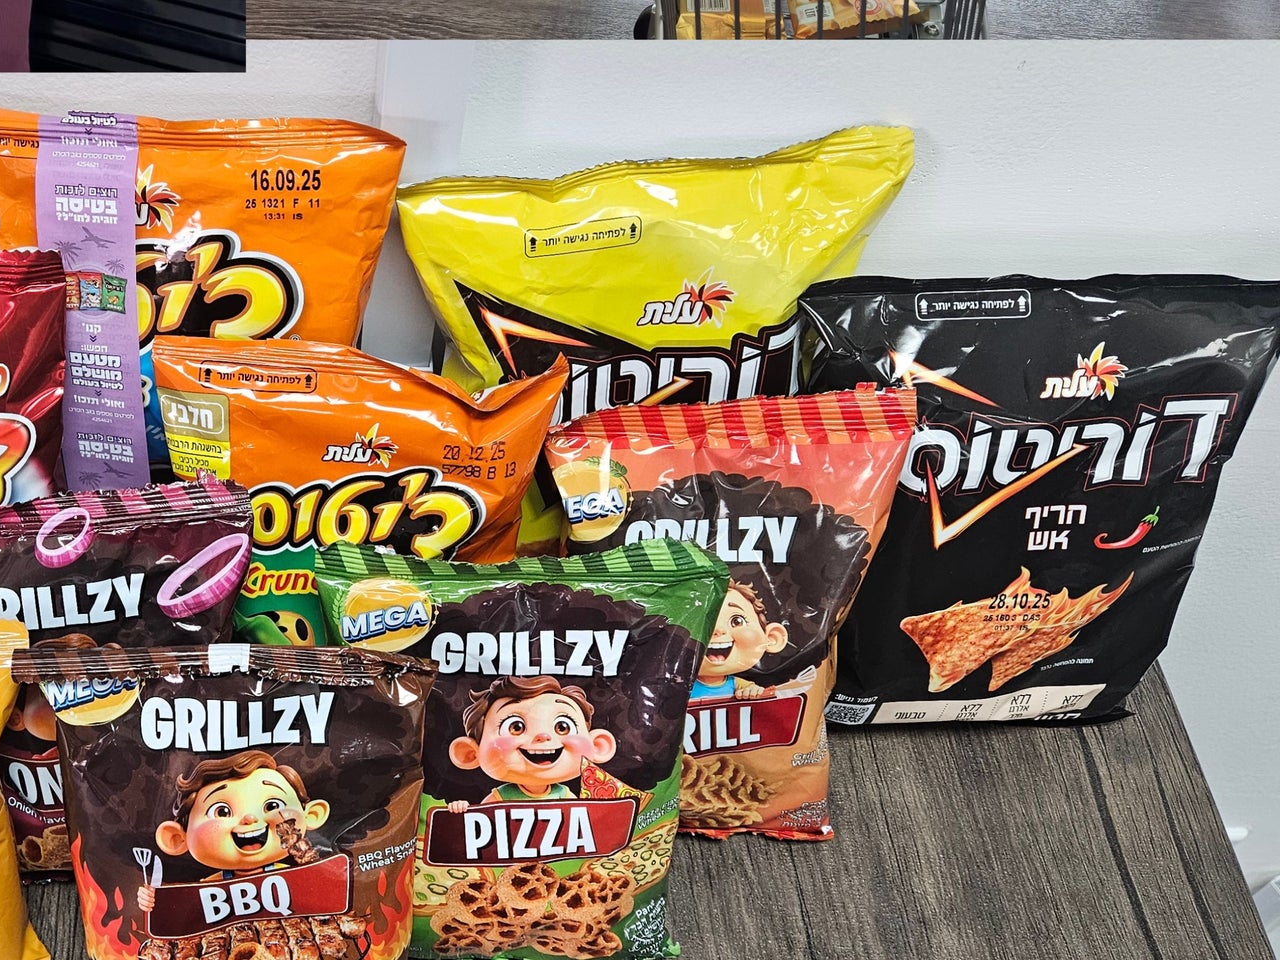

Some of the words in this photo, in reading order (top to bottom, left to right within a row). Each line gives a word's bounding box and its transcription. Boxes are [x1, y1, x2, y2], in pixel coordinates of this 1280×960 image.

[250, 169, 322, 191] 16.09.25
[55, 184, 85, 196] לזכות
[89, 186, 118, 198] רוצים
[55, 196, 118, 215] בטיסה
[245, 198, 257, 209] 25
[262, 198, 285, 208] 1321
[293, 198, 299, 208] F
[308, 198, 320, 208] 11
[92, 215, 118, 225] זוגית
[541, 236, 561, 248] יותר
[563, 232, 590, 245] נגישה
[593, 227, 626, 242] לפתיחה
[637, 293, 703, 327] עלית
[931, 300, 952, 312] יותר
[953, 299, 979, 311] נגישה
[981, 298, 1015, 311] לפתיחה
[69, 351, 122, 367] מטעם
[71, 365, 123, 381] מושלם
[216, 370, 234, 381] יותר
[237, 372, 264, 384] נגישה
[266, 373, 301, 385] לפתיחה
[1040, 368, 1098, 400] עלית
[101, 398, 125, 409] ואולי
[78, 440, 134, 457] בטיסה
[442, 443, 506, 462] 20.12.25
[898, 399, 1230, 492] דוריטוס
[325, 445, 373, 464] עלית
[442, 464, 481, 479] 57798
[487, 465, 497, 480] B
[504, 461, 516, 478] 13
[1024, 504, 1087, 530] חריף
[1026, 530, 1071, 551] אש
[243, 566, 318, 596] Crun
[988, 593, 1051, 609] 28.10.25
[342, 600, 431, 643] MEGA
[430, 628, 630, 677] GRILLZY
[50, 674, 138, 713] MEGA
[1011, 693, 1032, 705] ללא
[894, 711, 926, 720] טבעוני
[960, 703, 983, 712] ללא
[140, 692, 336, 753] GRILLZY
[682, 706, 761, 755] RILL
[7, 796, 38, 818] Onion
[463, 808, 599, 861] PIZZA
[358, 849, 383, 864] BBQ
[359, 857, 395, 873] Wheat
[199, 874, 293, 925] BBQ
